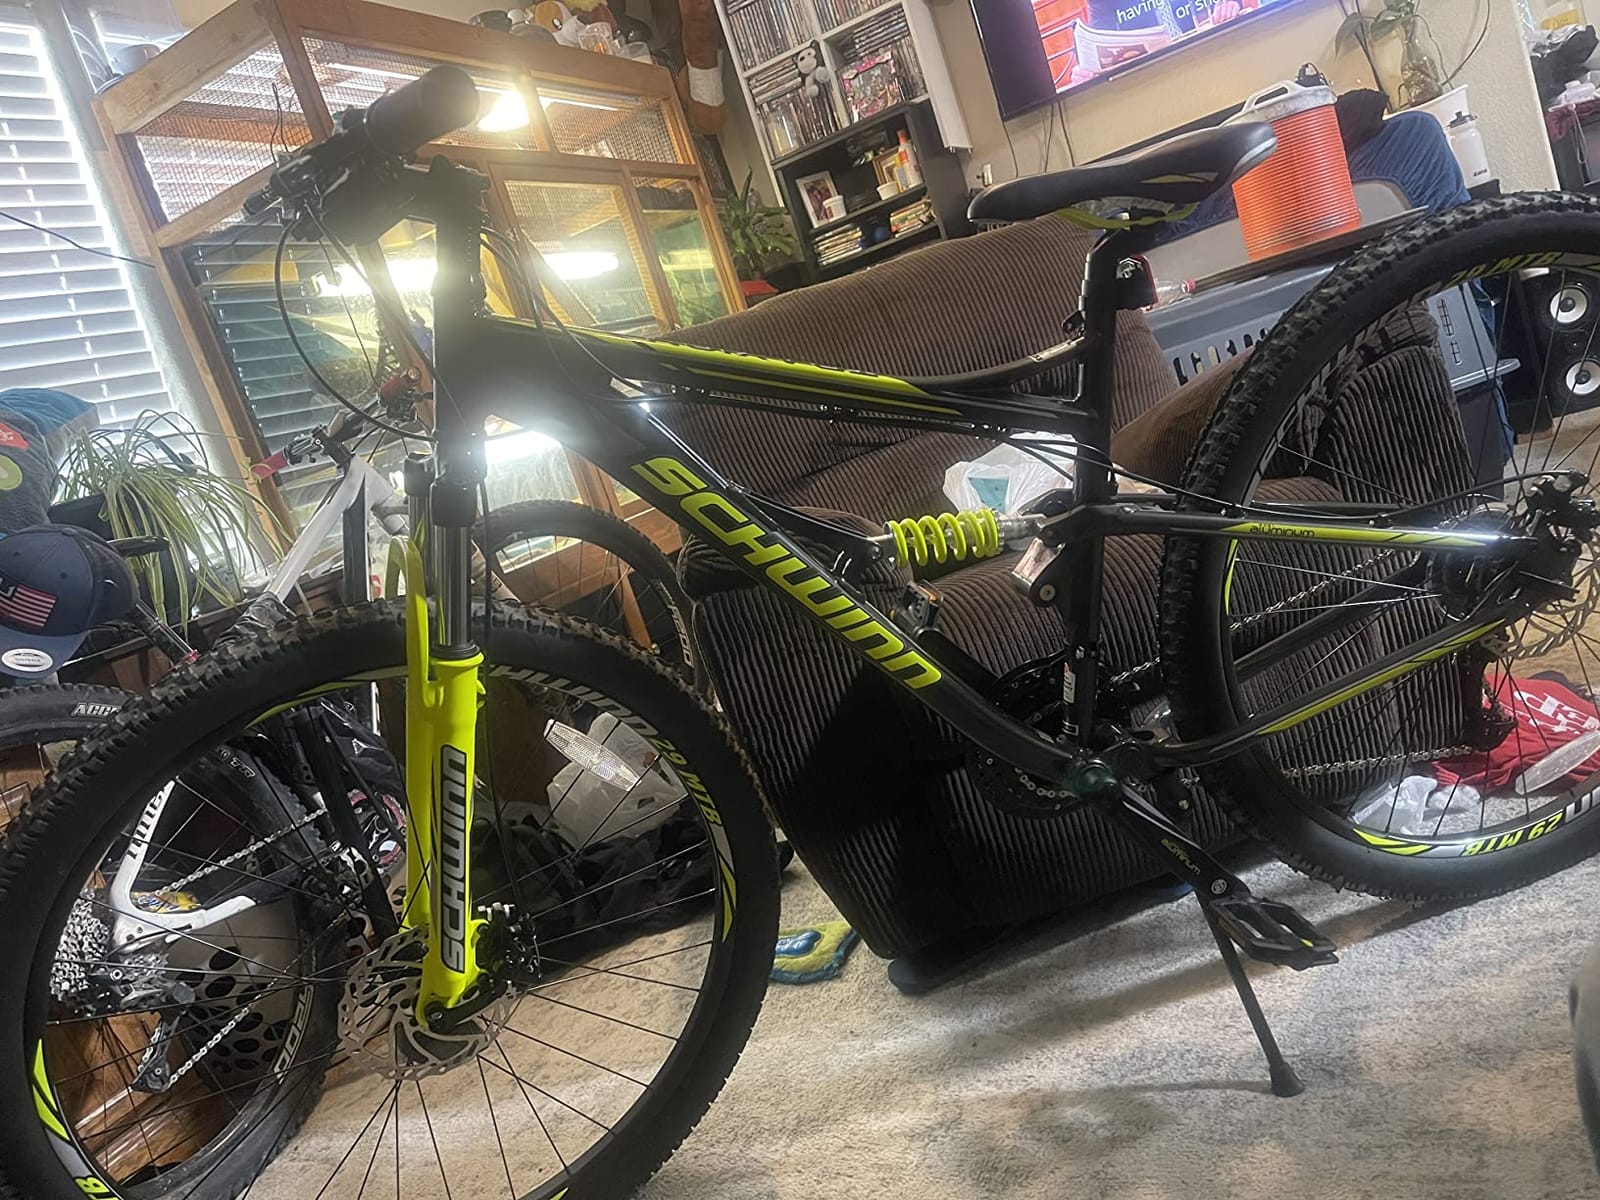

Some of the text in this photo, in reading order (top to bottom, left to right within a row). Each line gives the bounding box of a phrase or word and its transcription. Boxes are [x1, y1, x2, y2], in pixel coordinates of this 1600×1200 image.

[1115, 0, 1165, 24] having
[1175, 4, 1190, 19] or
[1487, 252, 1561, 277] MTB
[631, 457, 942, 689] SCHWINN
[651, 738, 688, 766] 29
[680, 769, 722, 826] MTB
[441, 744, 467, 972] SCHWINN
[1460, 812, 1564, 857] 29 MTB
